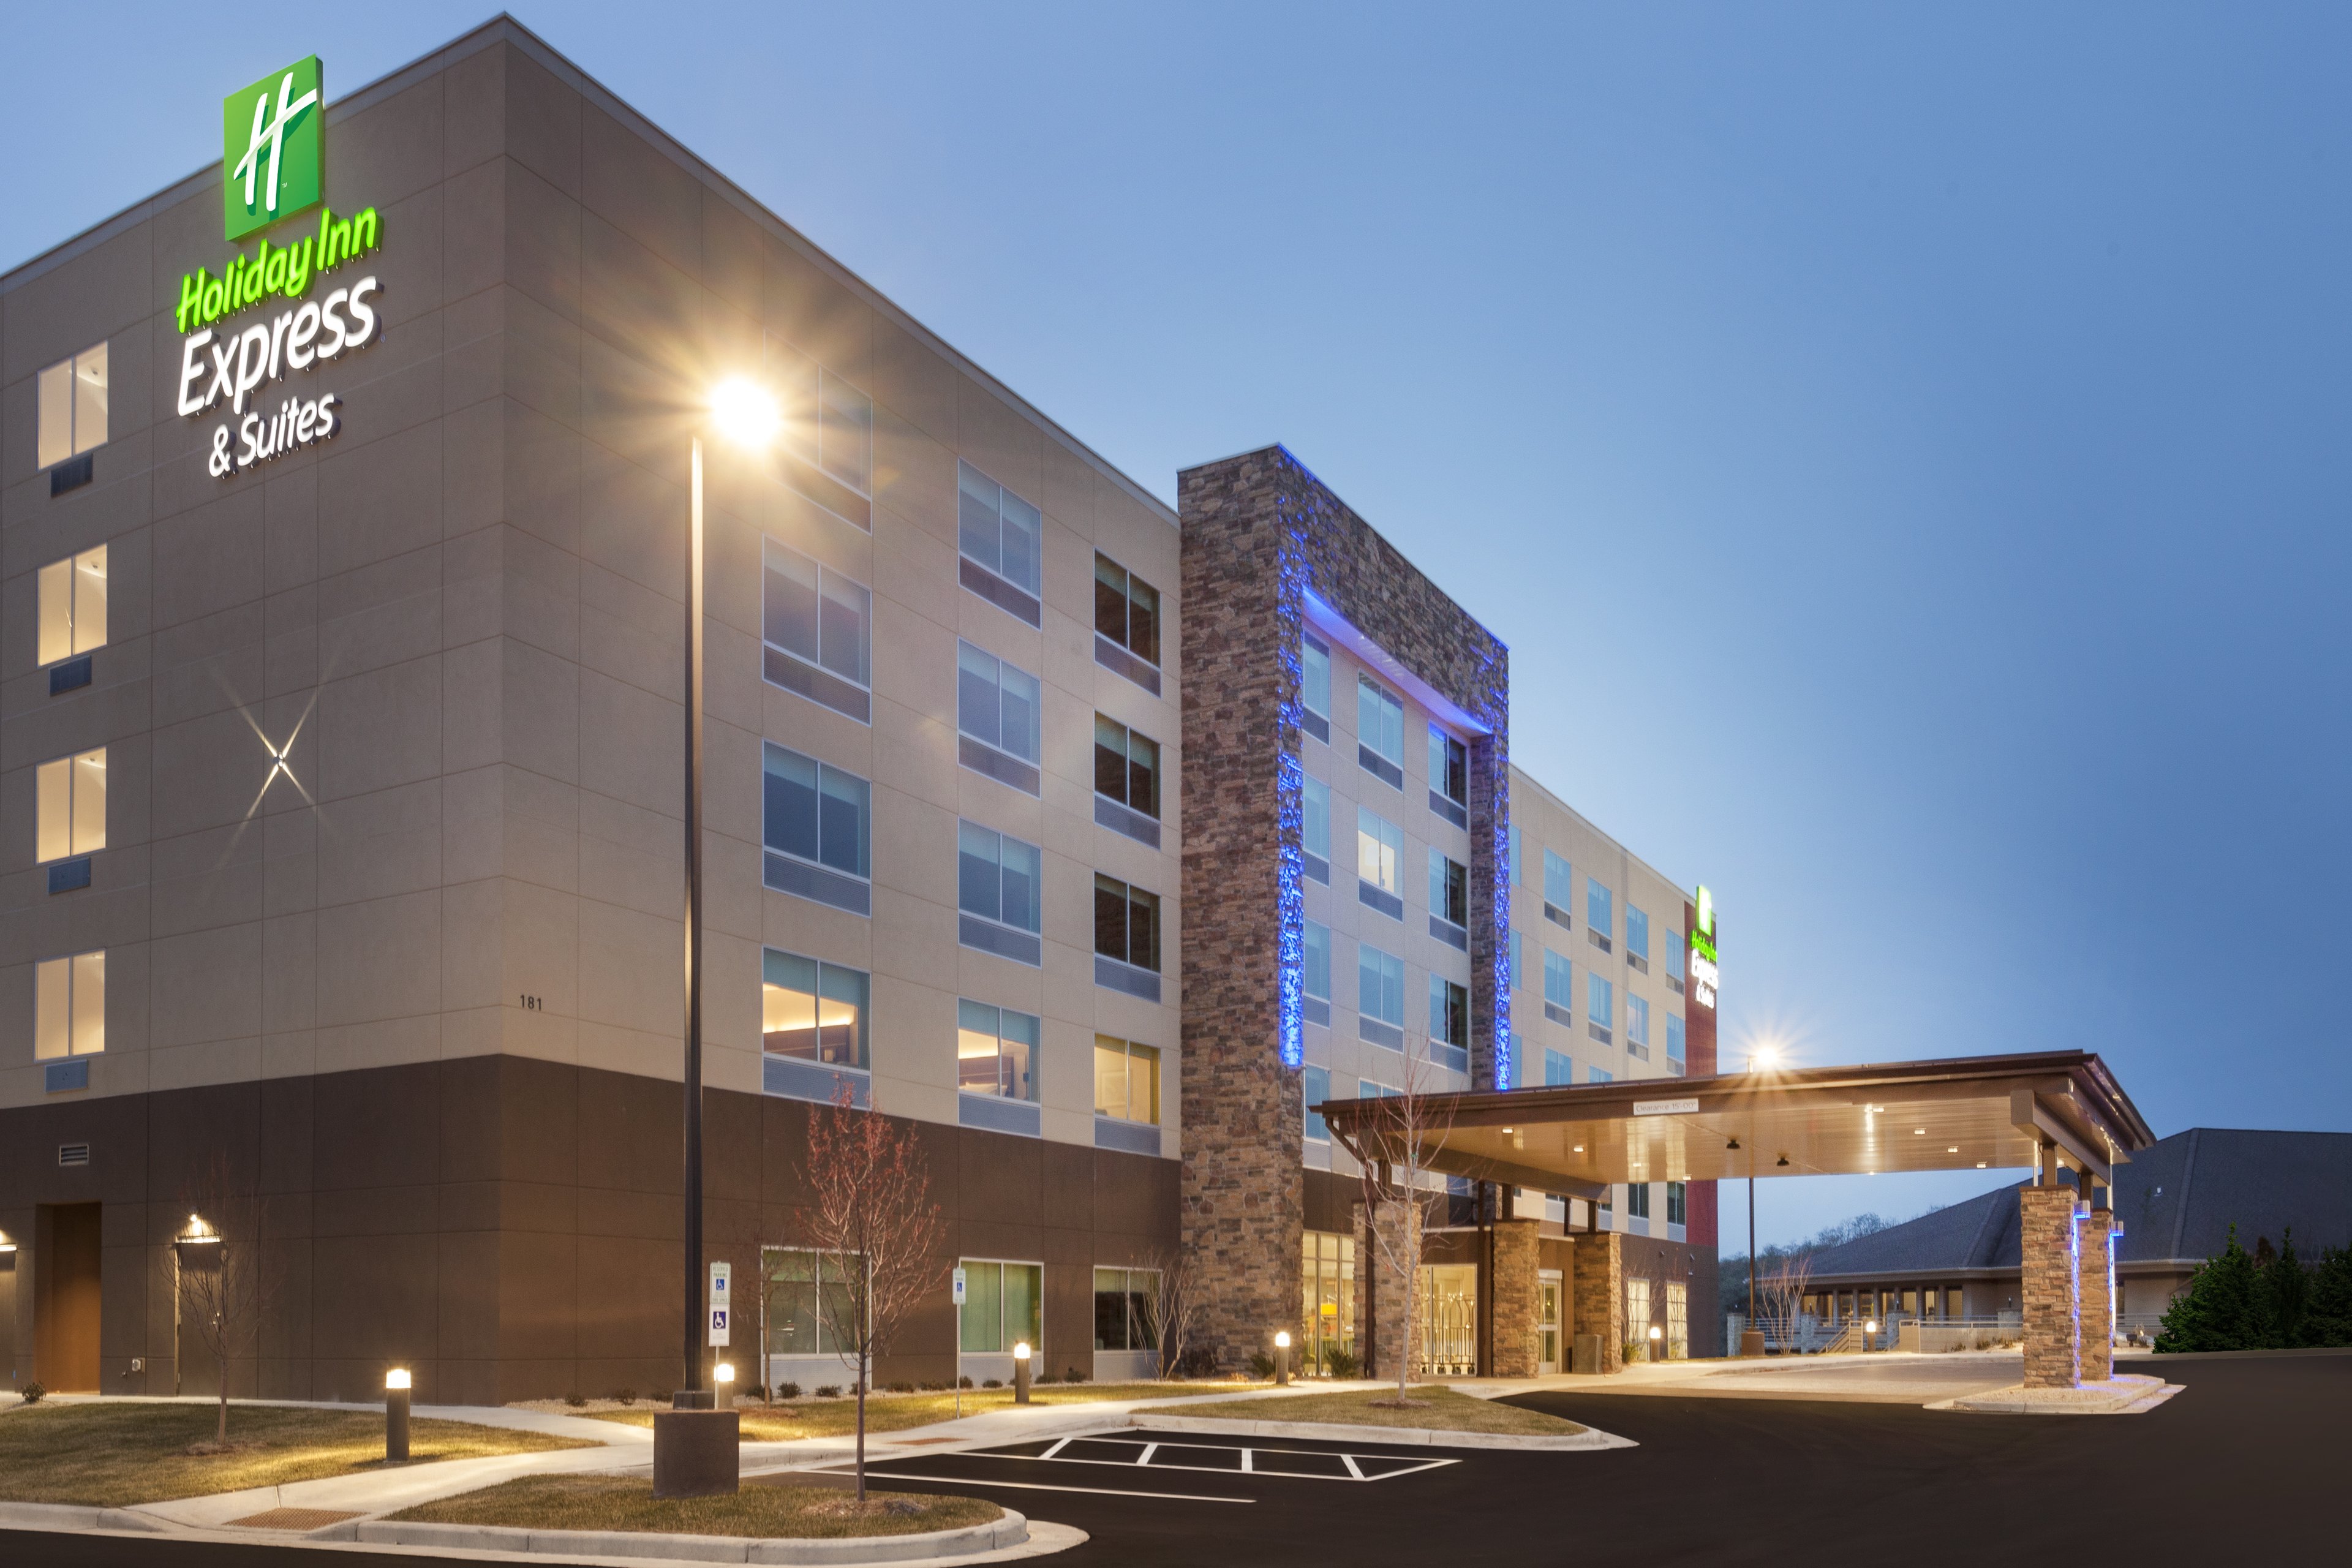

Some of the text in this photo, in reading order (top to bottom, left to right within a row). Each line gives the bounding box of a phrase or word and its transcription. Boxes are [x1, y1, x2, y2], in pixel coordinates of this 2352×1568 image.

[176, 206, 377, 333] Holiday Inn
[178, 276, 377, 417] Express
[208, 393, 335, 478] & Suites
[1691, 929, 1711, 961] Holiday
[519, 994, 541, 1012] 181
